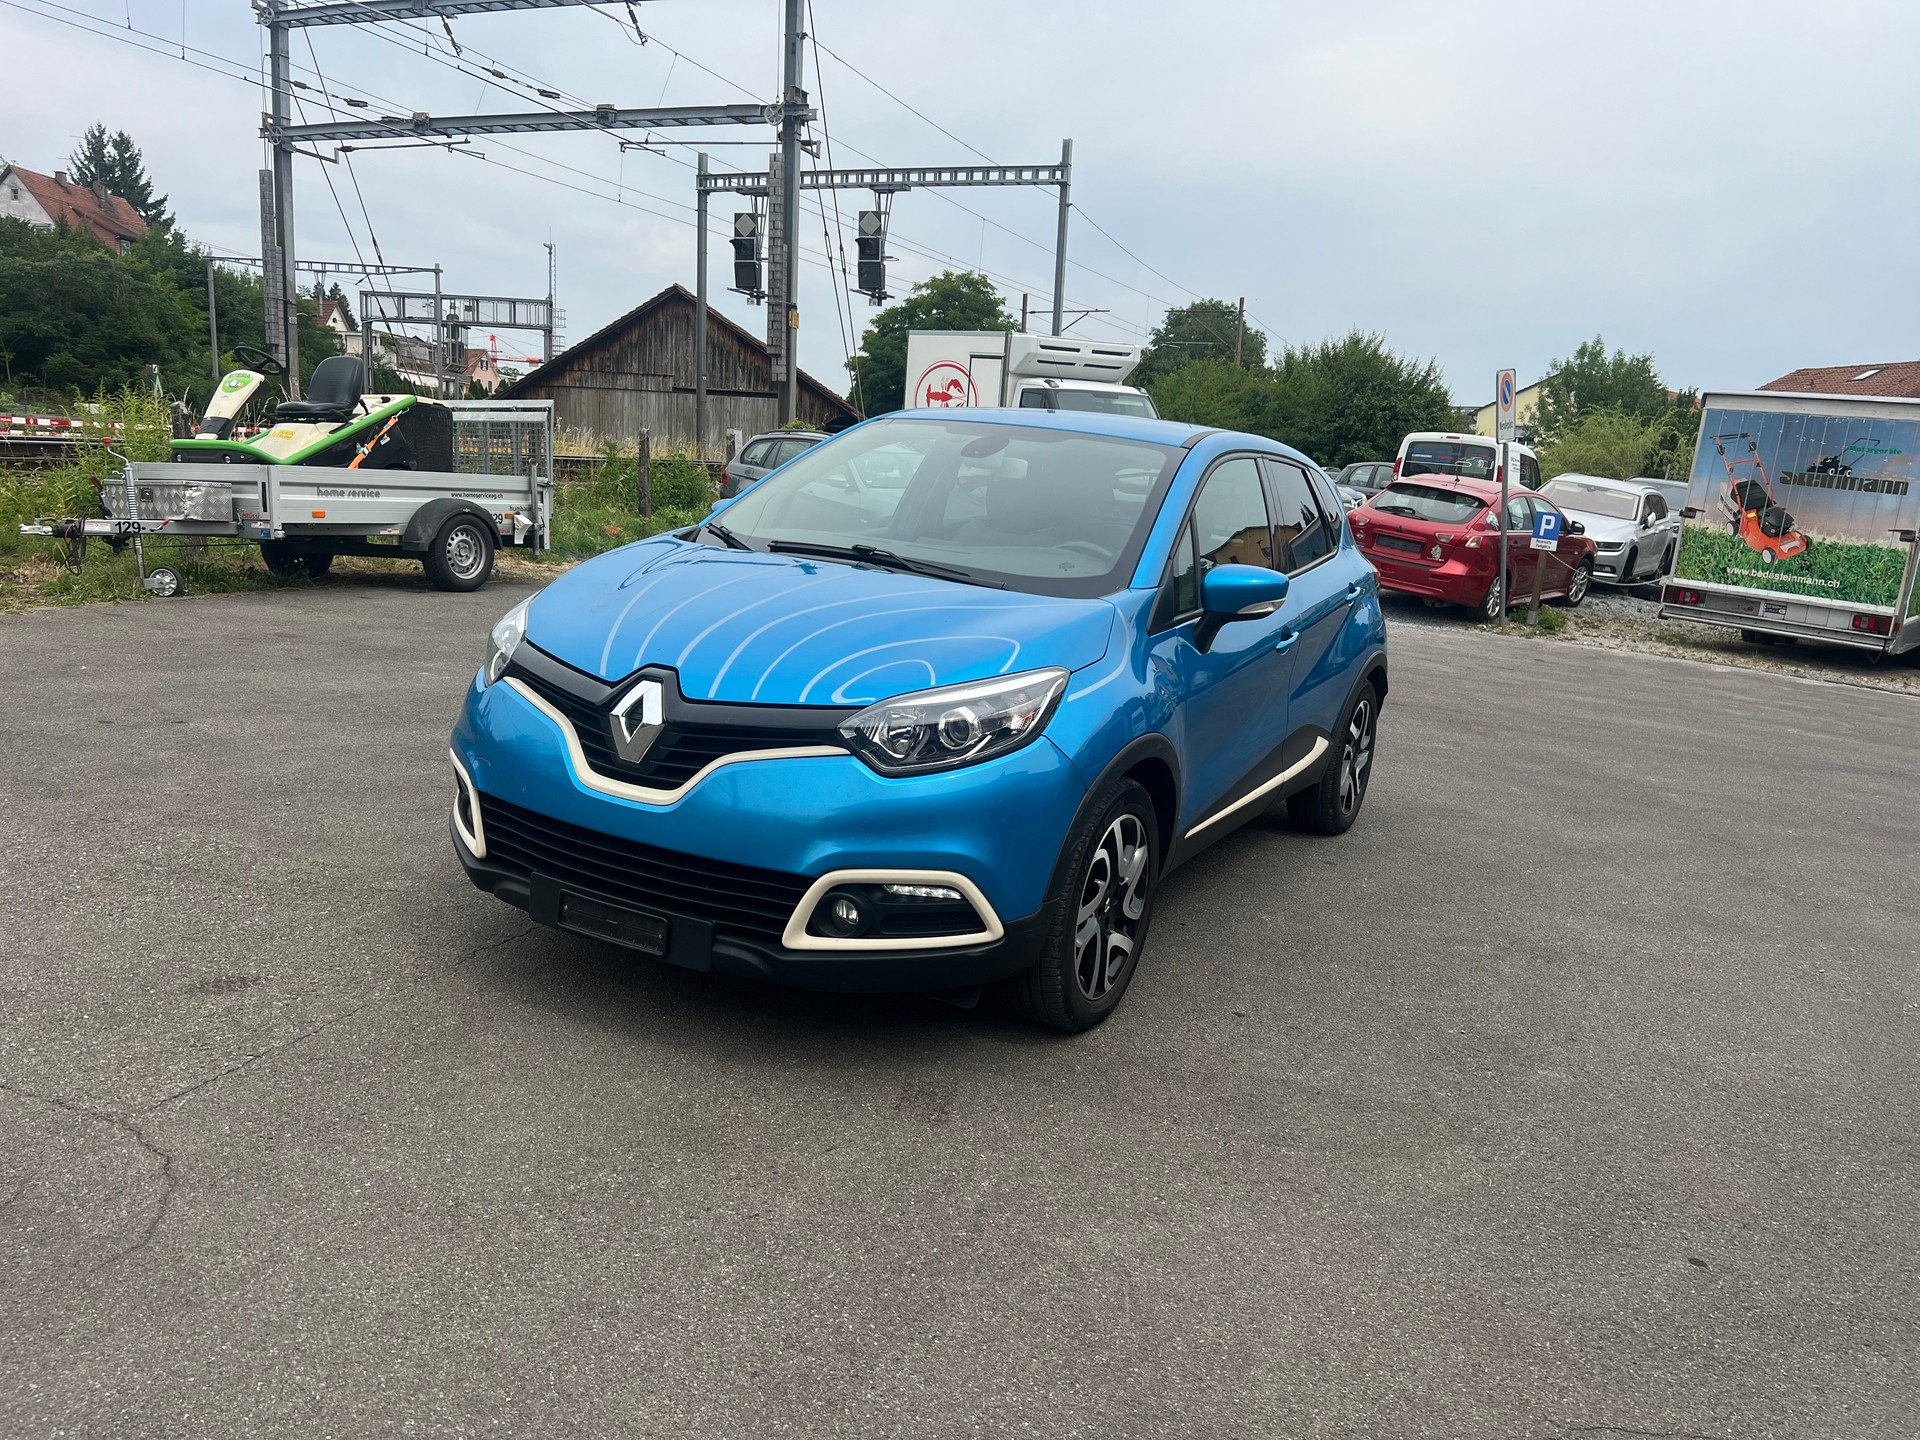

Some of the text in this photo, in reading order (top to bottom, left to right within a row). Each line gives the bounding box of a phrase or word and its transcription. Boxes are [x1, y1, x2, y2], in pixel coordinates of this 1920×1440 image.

[316, 486, 381, 498] home service
[490, 513, 504, 525] 29
[1539, 514, 1556, 537] P
